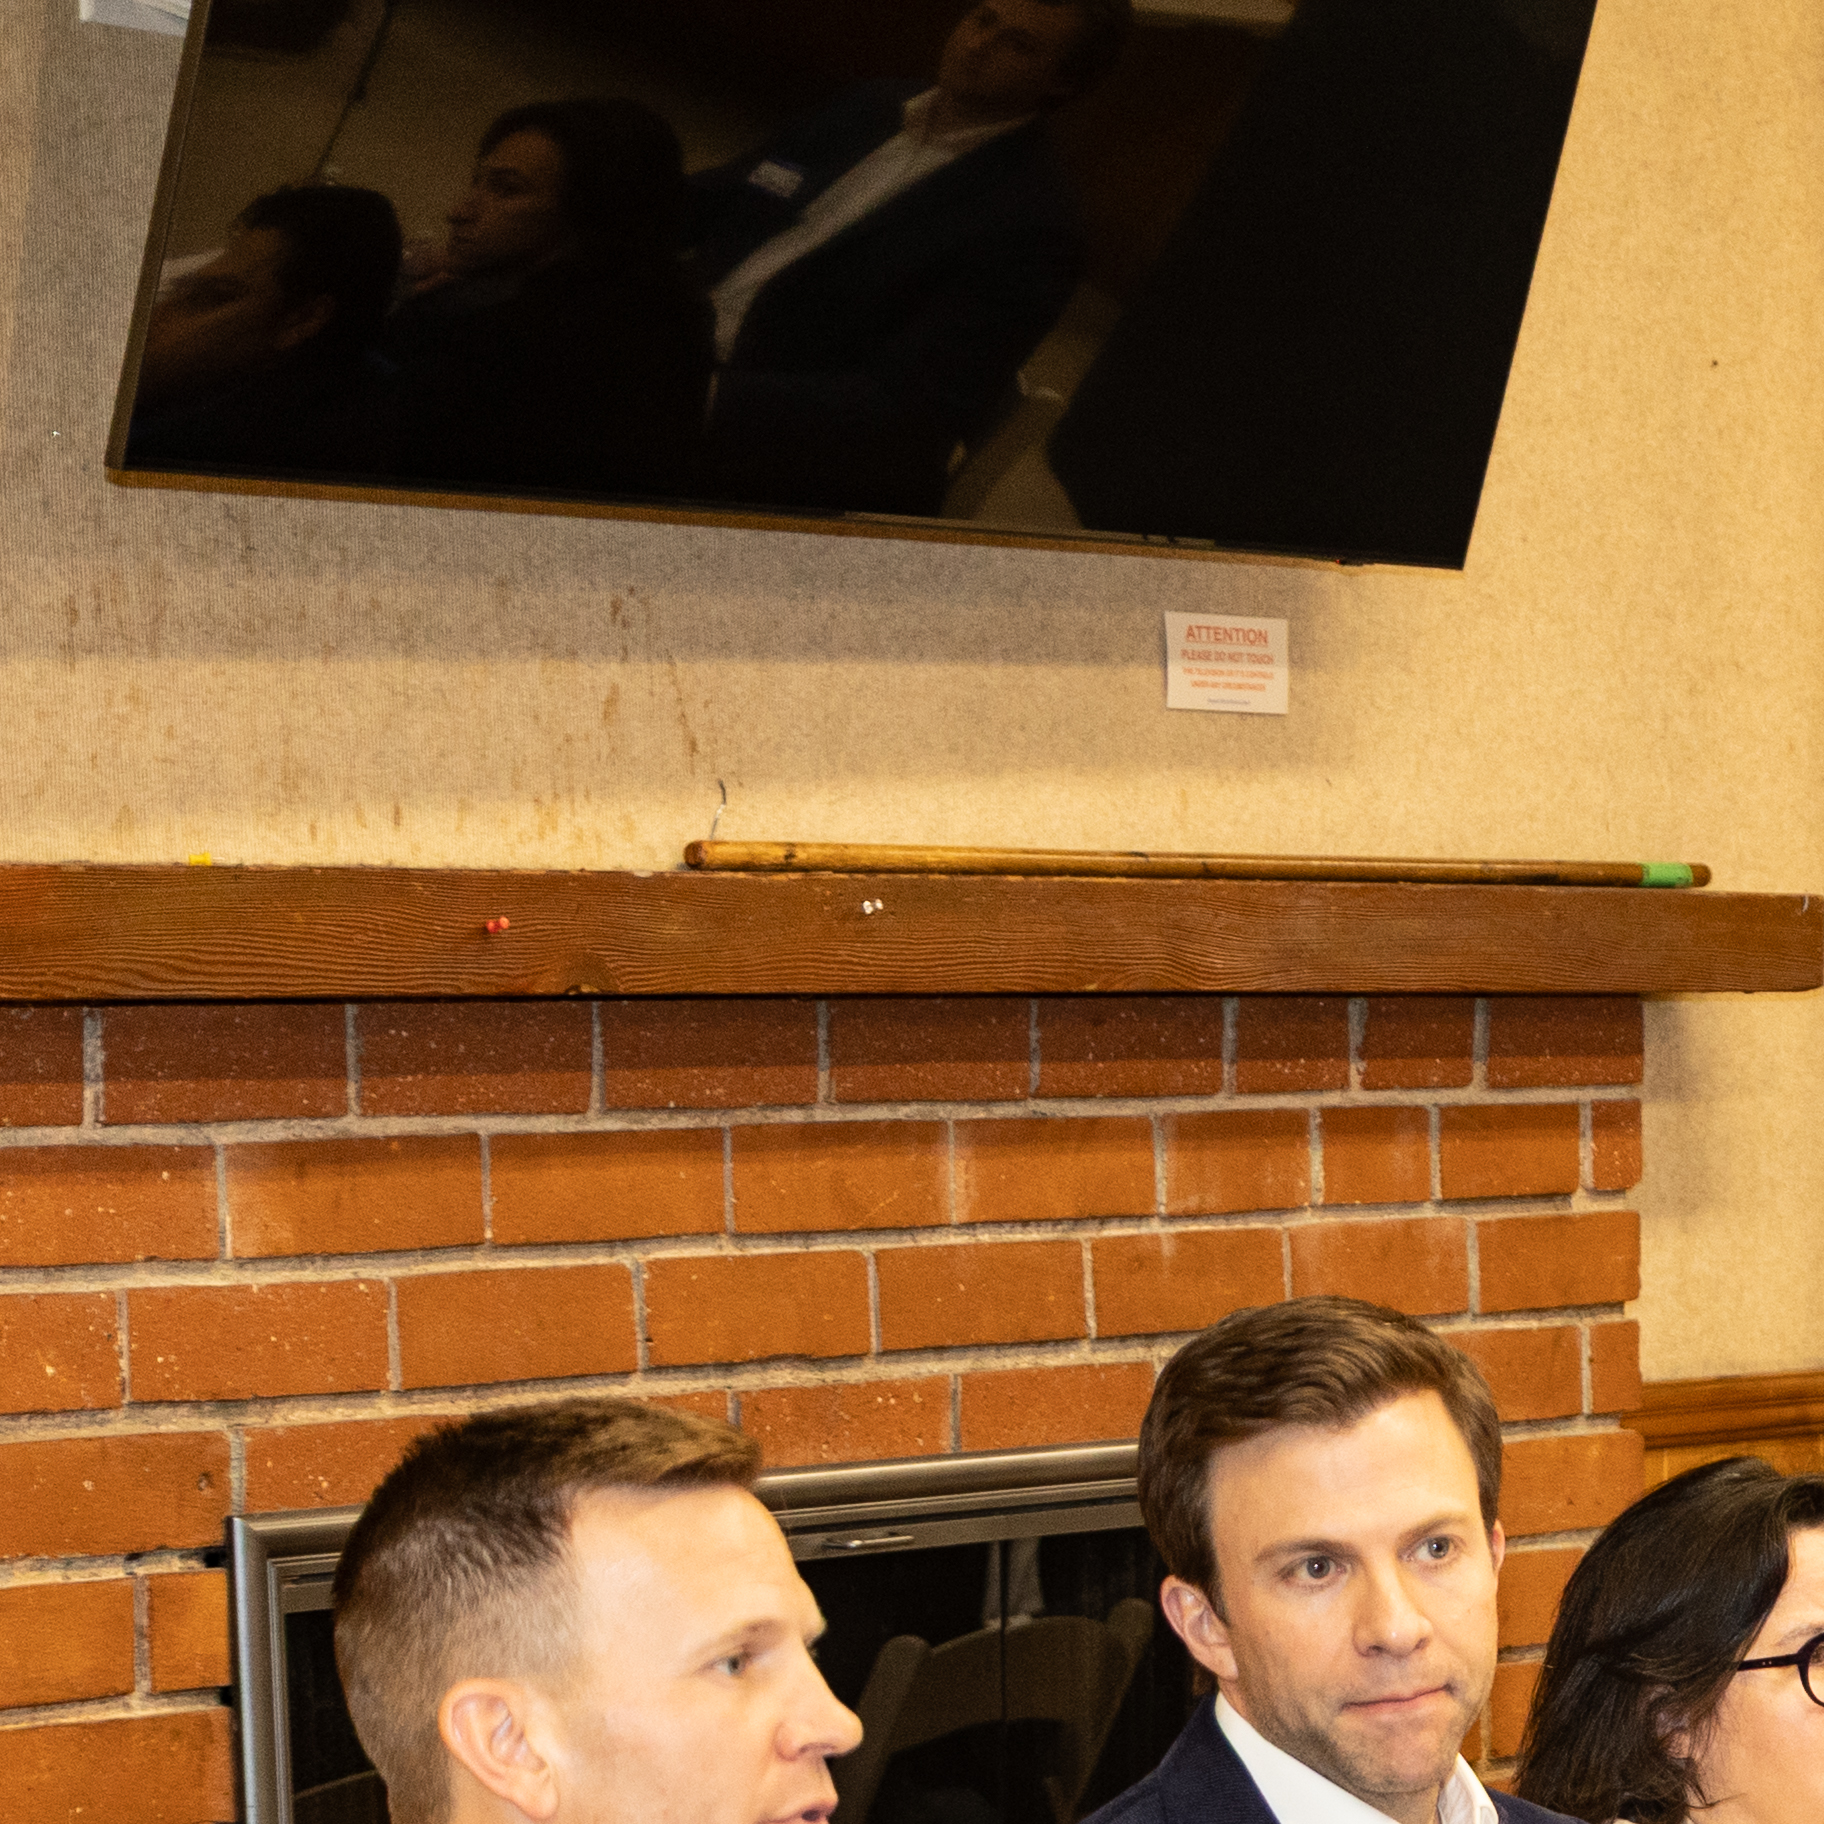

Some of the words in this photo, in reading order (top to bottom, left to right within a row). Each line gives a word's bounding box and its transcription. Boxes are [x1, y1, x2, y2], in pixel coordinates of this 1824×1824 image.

[1186, 625, 1268, 646] ATTENTION
[1181, 649, 1212, 661] PLEASE
[1214, 650, 1226, 662] DO
[1228, 651, 1243, 663] NOT
[1246, 653, 1274, 665] TOUCH
